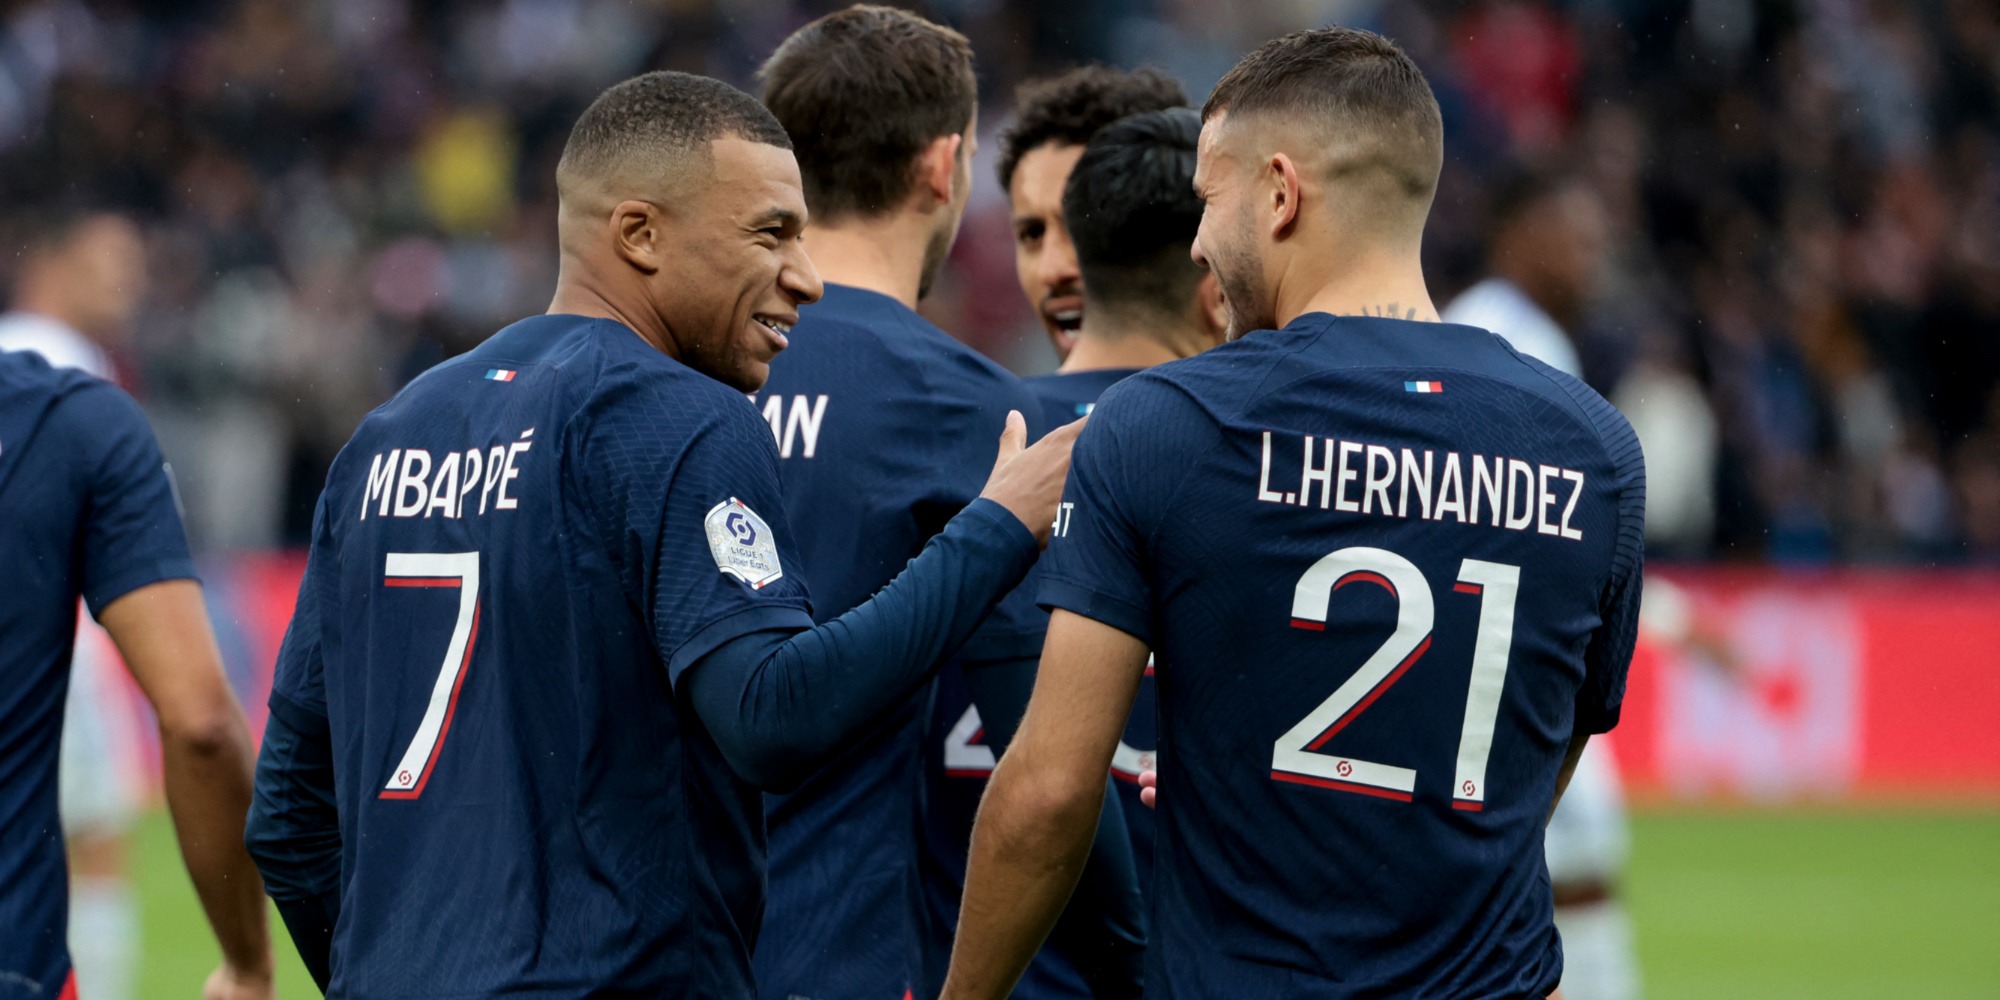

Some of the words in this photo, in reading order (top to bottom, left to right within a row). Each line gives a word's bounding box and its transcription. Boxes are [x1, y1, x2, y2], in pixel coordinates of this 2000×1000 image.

[360, 427, 535, 521] MBAPPÉ
[1257, 431, 1584, 541] L.HERNANDEZ
[727, 555, 748, 567] Uber
[750, 559, 770, 571] Eats
[730, 546, 758, 559] LIGUE
[378, 551, 482, 800] 7
[1271, 547, 1521, 811] 21
